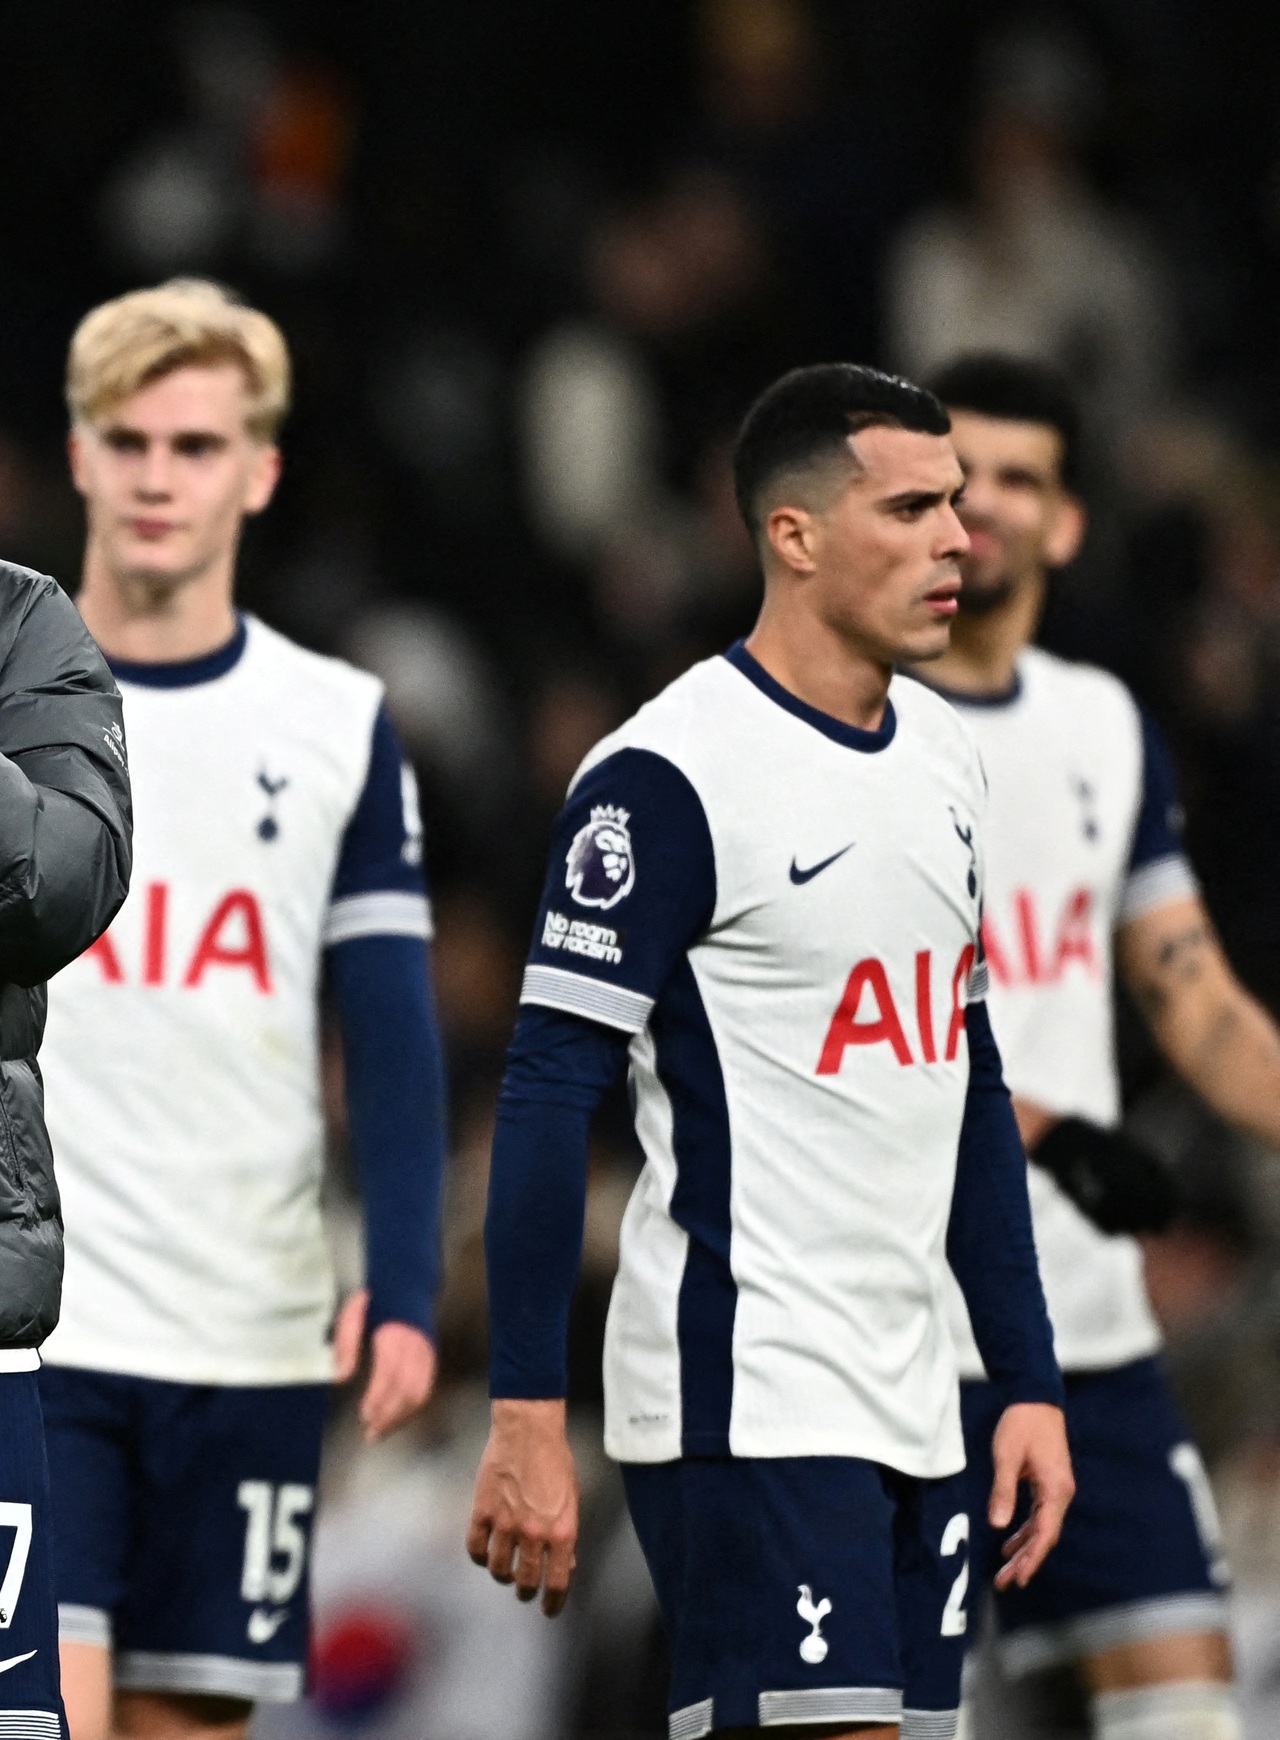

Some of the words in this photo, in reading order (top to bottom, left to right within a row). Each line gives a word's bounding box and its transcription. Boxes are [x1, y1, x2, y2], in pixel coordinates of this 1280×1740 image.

[545, 911, 569, 933] No
[569, 920, 617, 946] room
[563, 935, 622, 964] racism
[237, 1479, 314, 1602] 15
